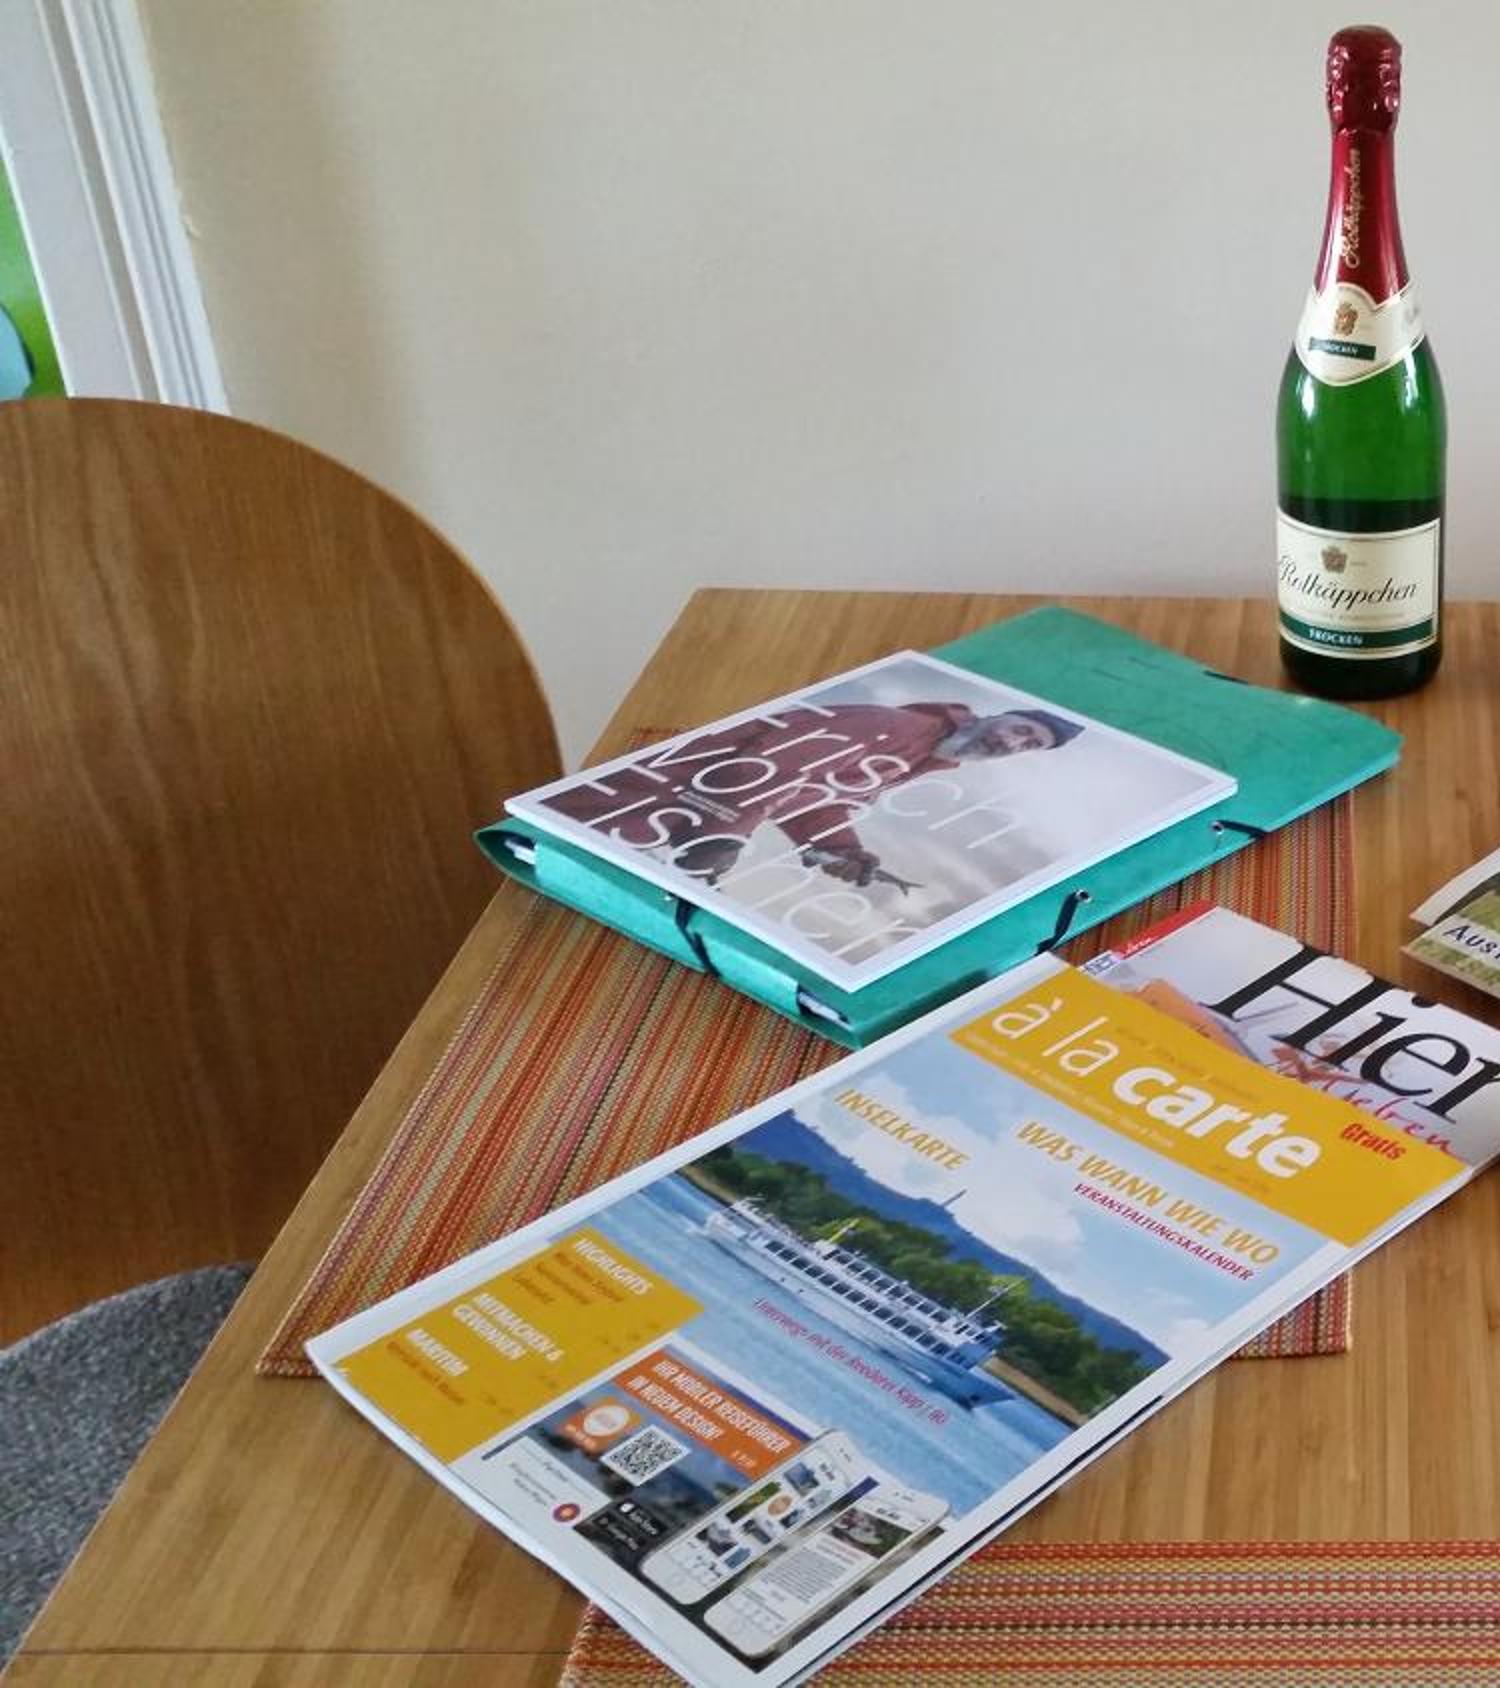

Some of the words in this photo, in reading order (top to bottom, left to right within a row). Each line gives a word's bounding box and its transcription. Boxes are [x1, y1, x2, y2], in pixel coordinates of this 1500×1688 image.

[1309, 627, 1364, 646] TROCKEN
[835, 1088, 972, 1171] INSELKARTE
[991, 997, 1063, 1039] à
[1042, 1015, 1120, 1077] la
[1112, 1066, 1323, 1178] carte
[1340, 1122, 1407, 1161] Gratis
[1016, 1120, 1083, 1162] WAS
[1078, 1154, 1168, 1209] WANN
[1163, 1198, 1227, 1238] WIE
[1220, 1227, 1280, 1265] WO
[1072, 1182, 1256, 1283] VERANSTALTUNGSKALENDER
